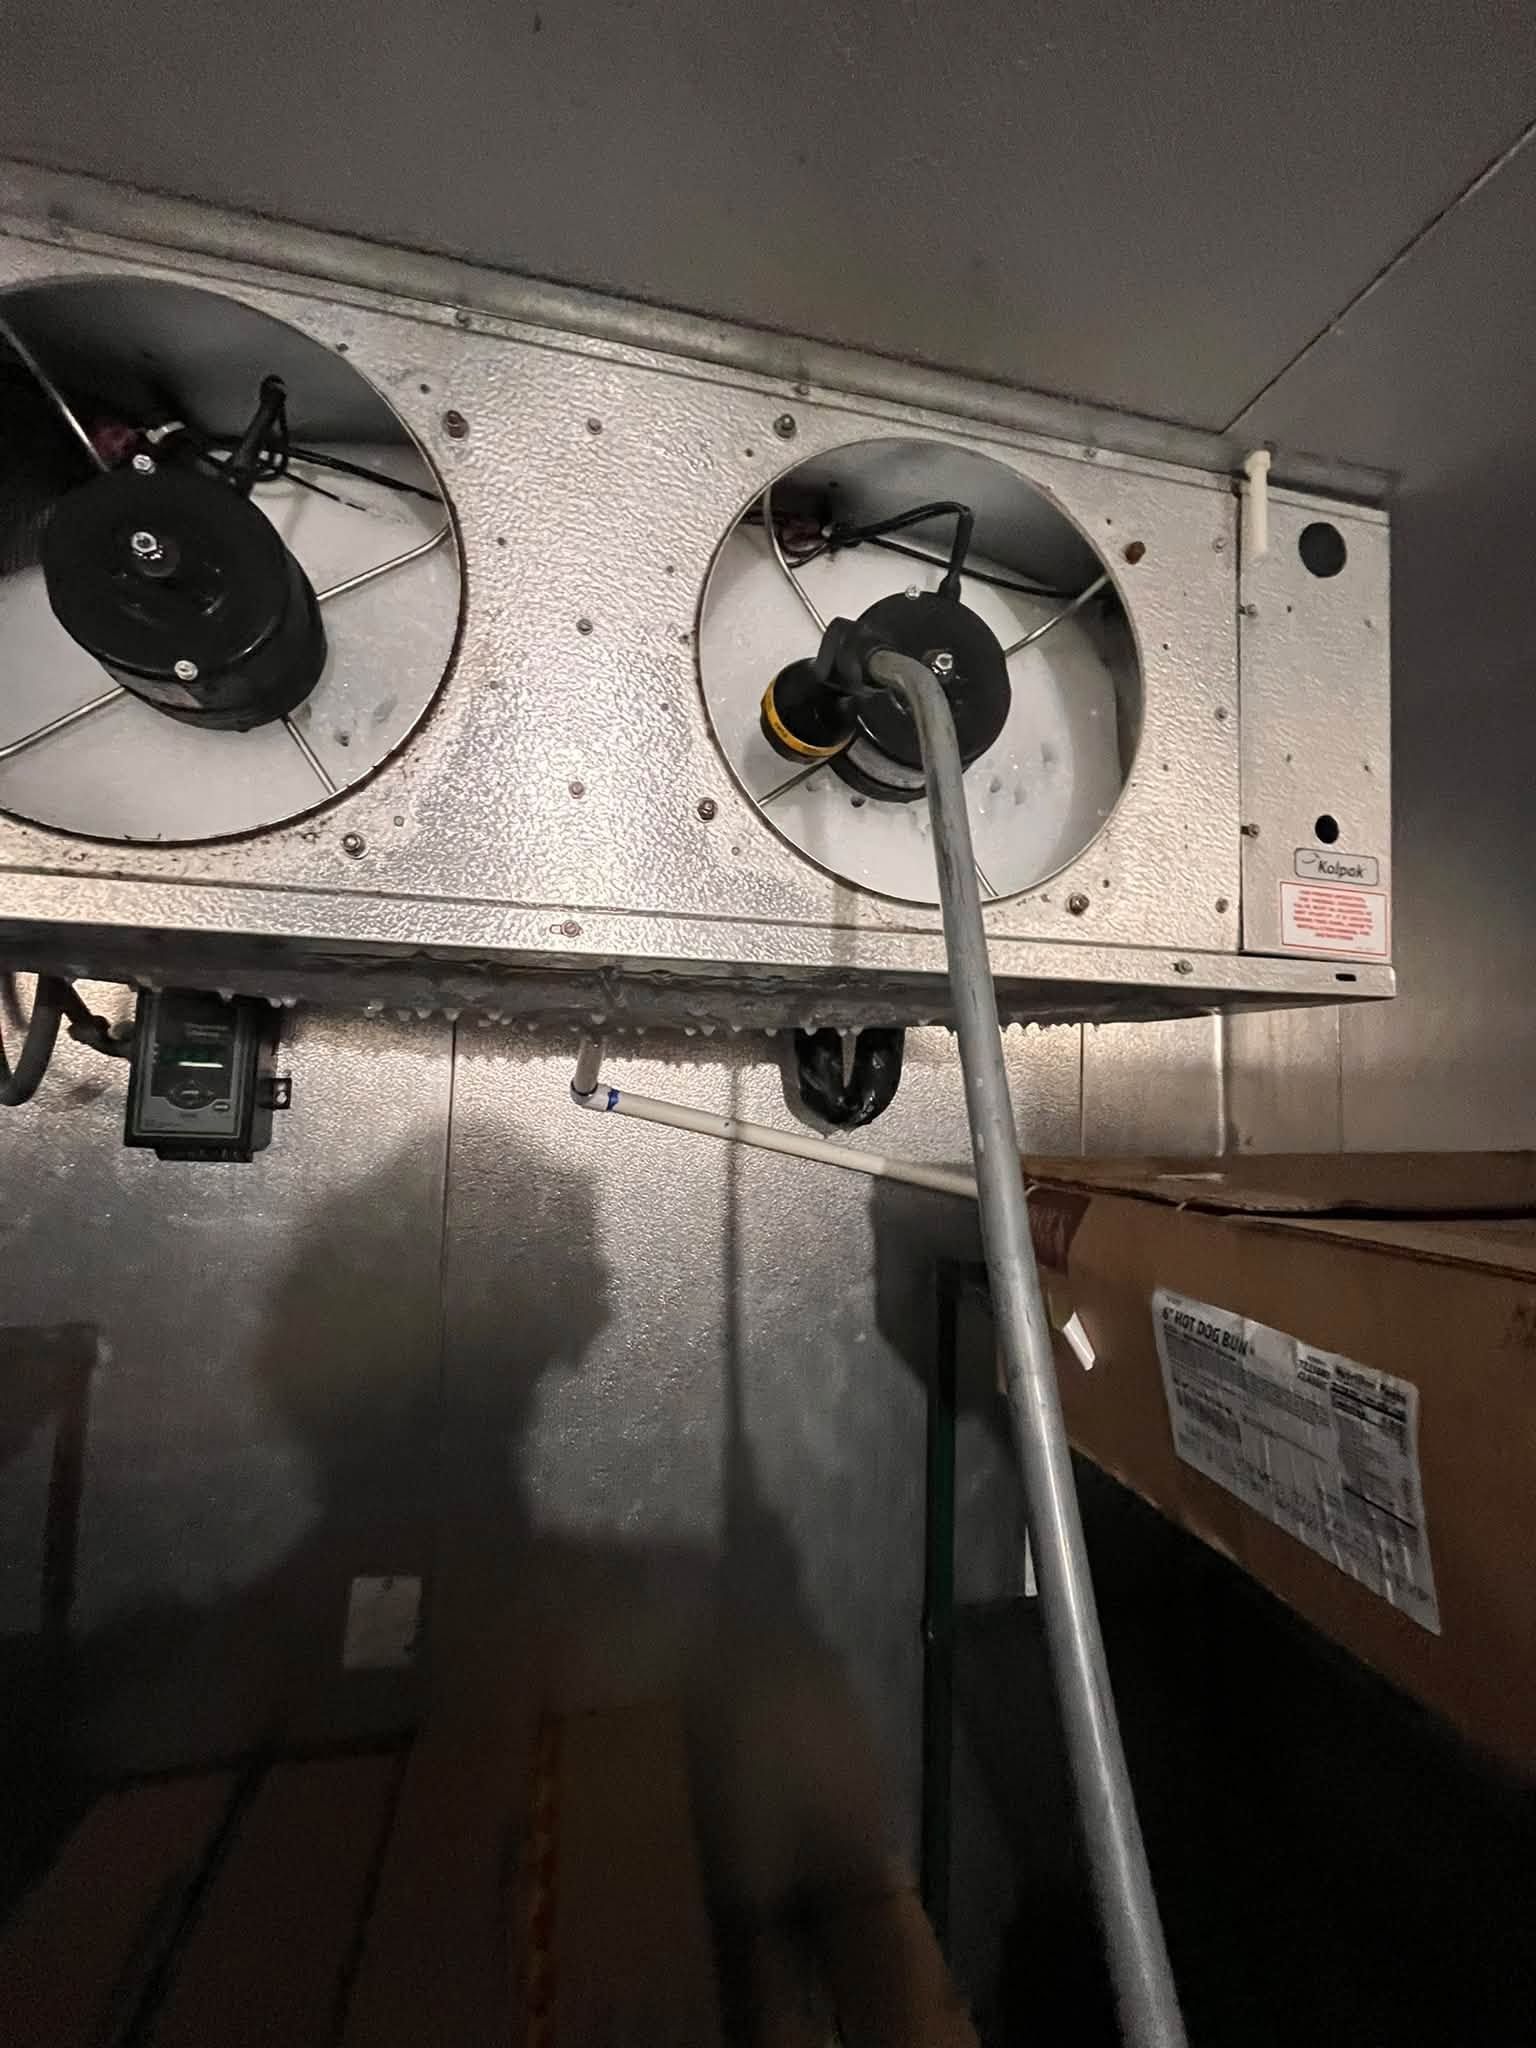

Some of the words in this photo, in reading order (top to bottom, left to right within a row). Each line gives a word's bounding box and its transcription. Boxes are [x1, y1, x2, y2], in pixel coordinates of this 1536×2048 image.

[1317, 860, 1366, 878] Kolpak
[1174, 1311, 1196, 1332] HOT
[1197, 1320, 1221, 1345] DOG
